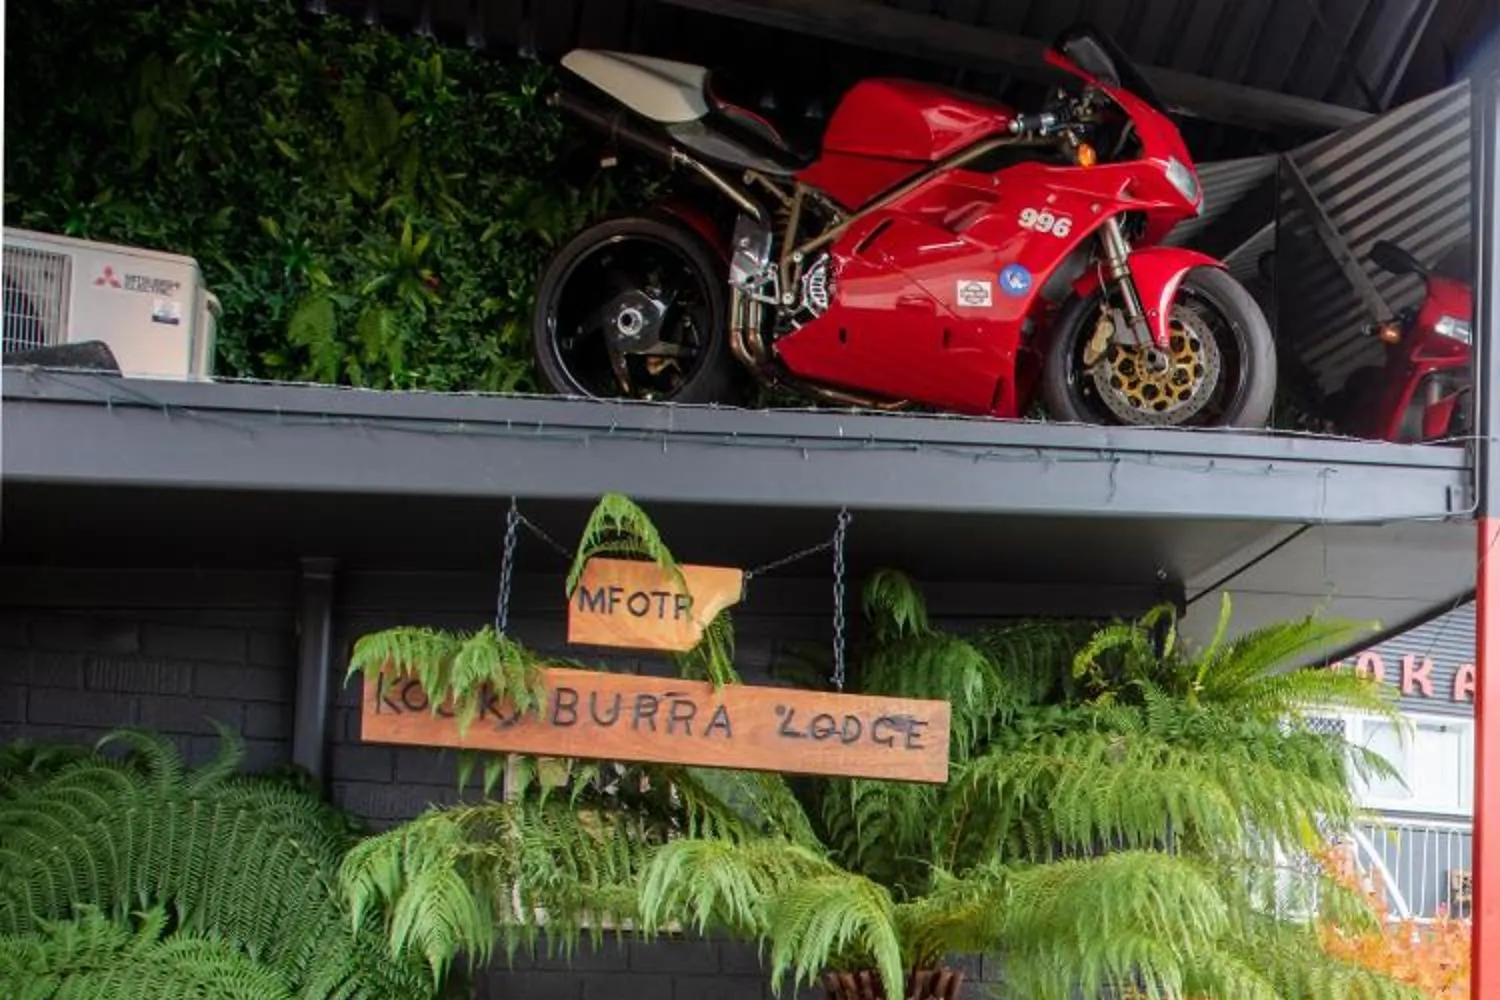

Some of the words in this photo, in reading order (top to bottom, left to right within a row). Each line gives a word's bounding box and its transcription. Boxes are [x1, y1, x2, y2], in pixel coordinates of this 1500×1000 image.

[1018, 207, 1073, 238] 996
[375, 671, 733, 738] KOKBURRA
[775, 704, 928, 750] LODGE
